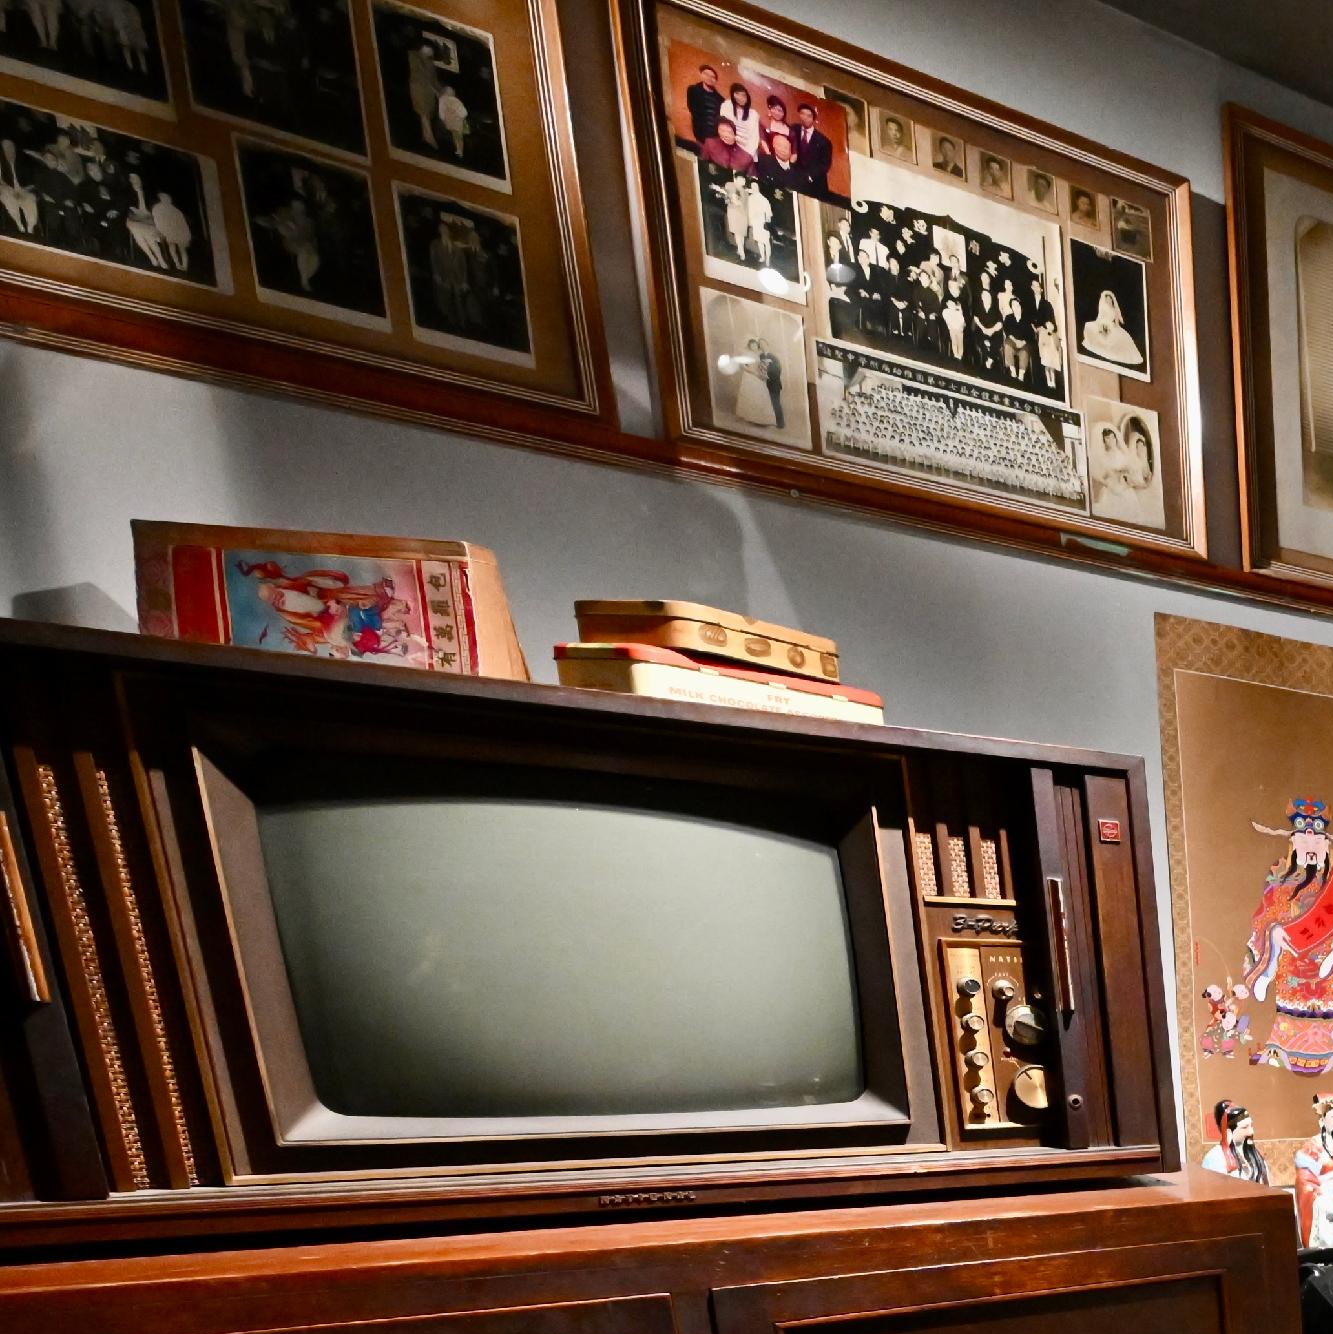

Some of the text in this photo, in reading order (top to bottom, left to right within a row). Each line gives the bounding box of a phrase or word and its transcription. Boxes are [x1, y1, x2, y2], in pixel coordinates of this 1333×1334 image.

[668, 686, 704, 701] MILK
[709, 693, 783, 714] CHOCOLATE
[766, 693, 790, 706] FRY
